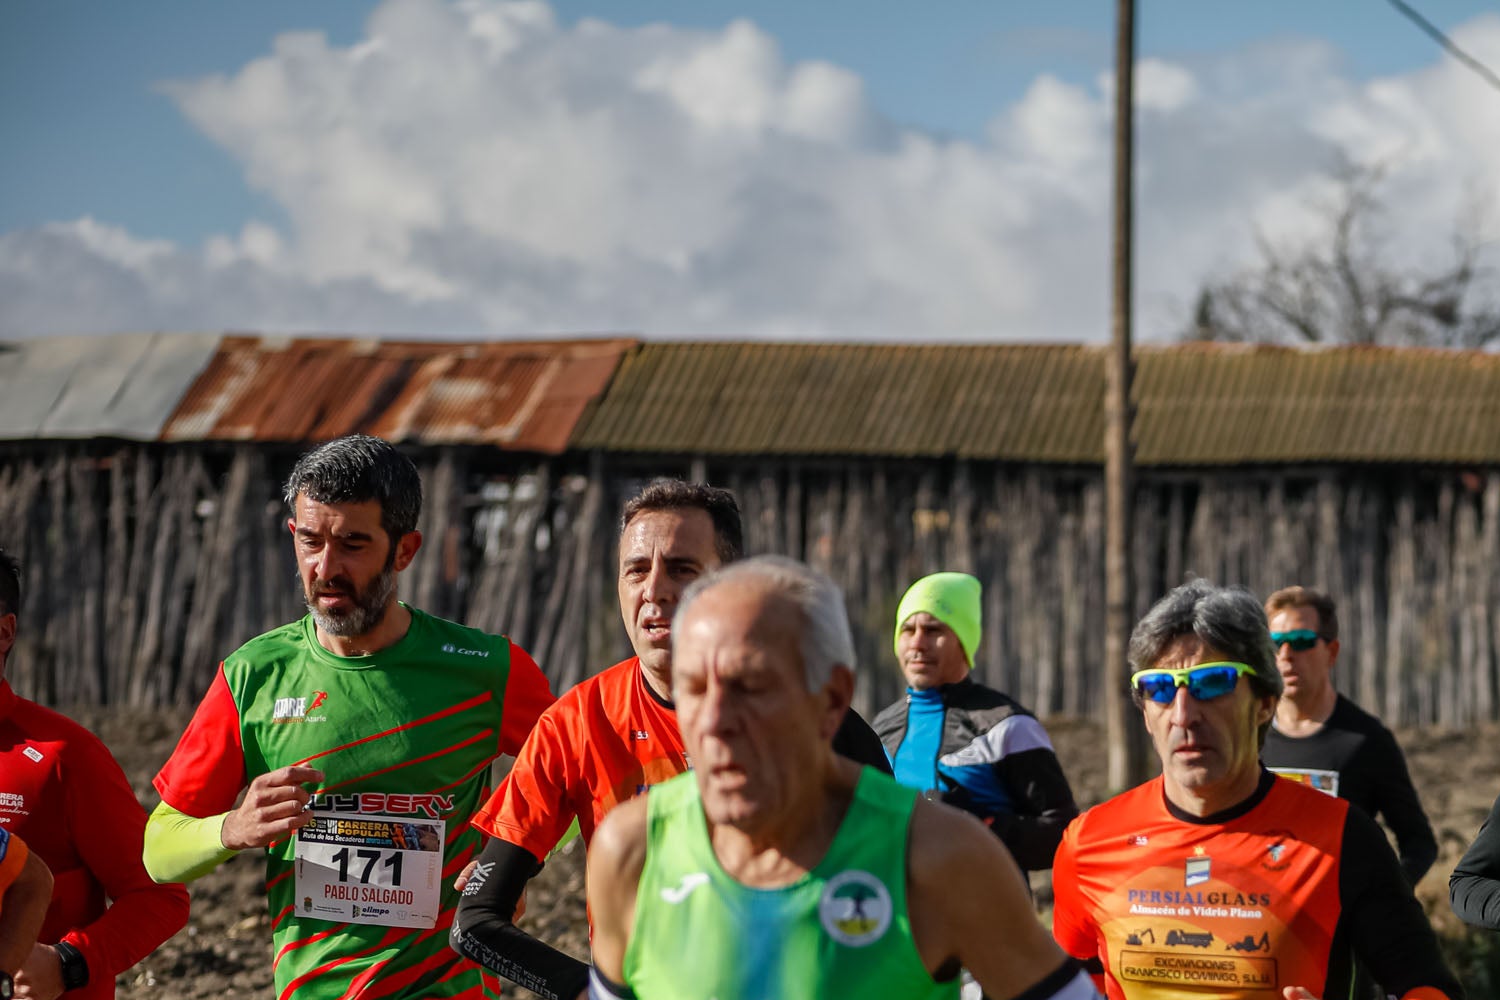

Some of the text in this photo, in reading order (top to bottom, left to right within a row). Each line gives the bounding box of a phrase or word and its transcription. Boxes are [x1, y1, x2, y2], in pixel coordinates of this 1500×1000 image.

[337, 819, 390, 832] CARRERA
[302, 831, 316, 840] Ruta
[325, 833, 334, 841] los
[335, 834, 365, 844] Secaderos
[337, 828, 390, 838] POPULAR
[332, 847, 403, 887] 171
[324, 884, 414, 906] PABLO SALGADO
[361, 905, 390, 915] olimpo
[1129, 903, 1263, 919] Almacén de Vidrio Plano
[1154, 957, 1236, 970] EXCAVACIONES
[1125, 967, 1182, 979] FRANCISCO
[1184, 969, 1240, 984] DOMINGO,
